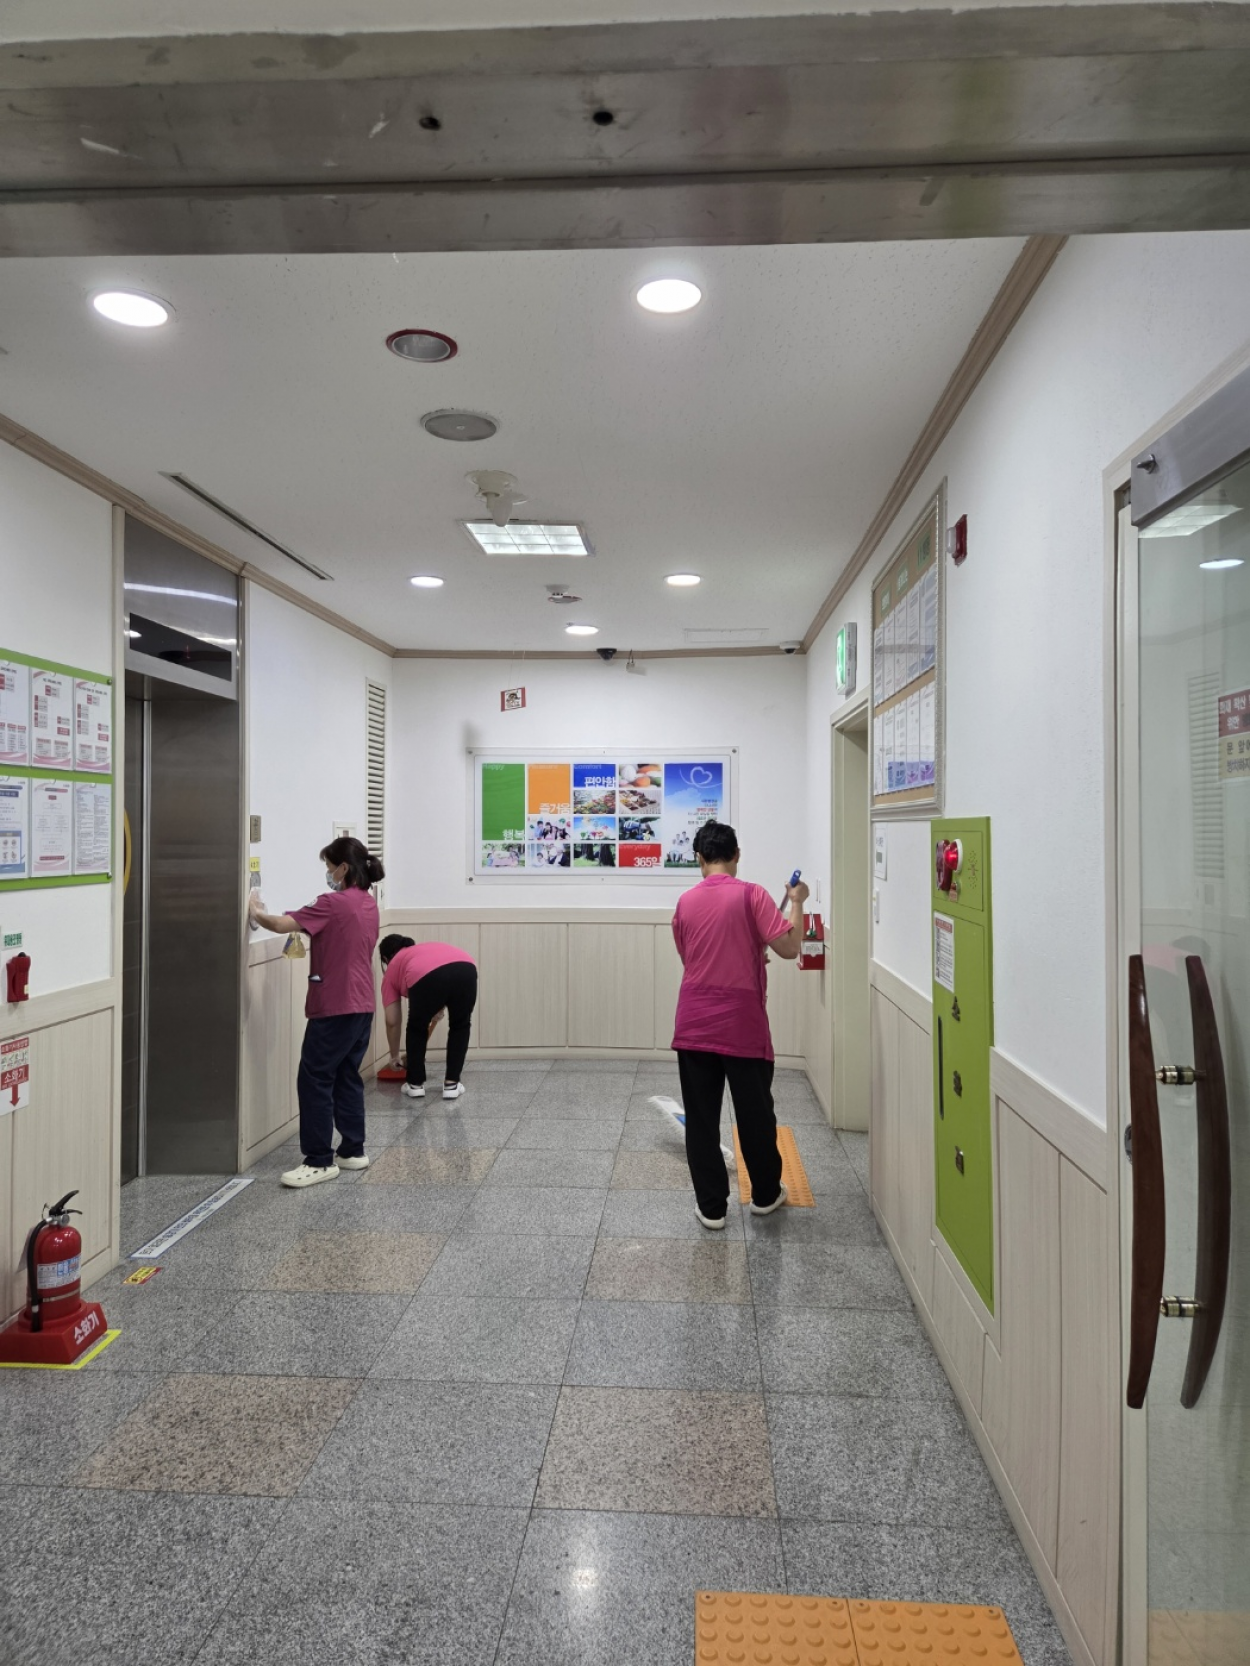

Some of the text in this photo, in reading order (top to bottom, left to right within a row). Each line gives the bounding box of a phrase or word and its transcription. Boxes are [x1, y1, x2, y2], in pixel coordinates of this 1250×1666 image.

[584, 775, 617, 789] 편안함
[539, 802, 572, 815] 즐거움
[502, 829, 526, 841] 행복
[4, 1068, 25, 1085] 소화기
[74, 1311, 100, 1346] 소화기
